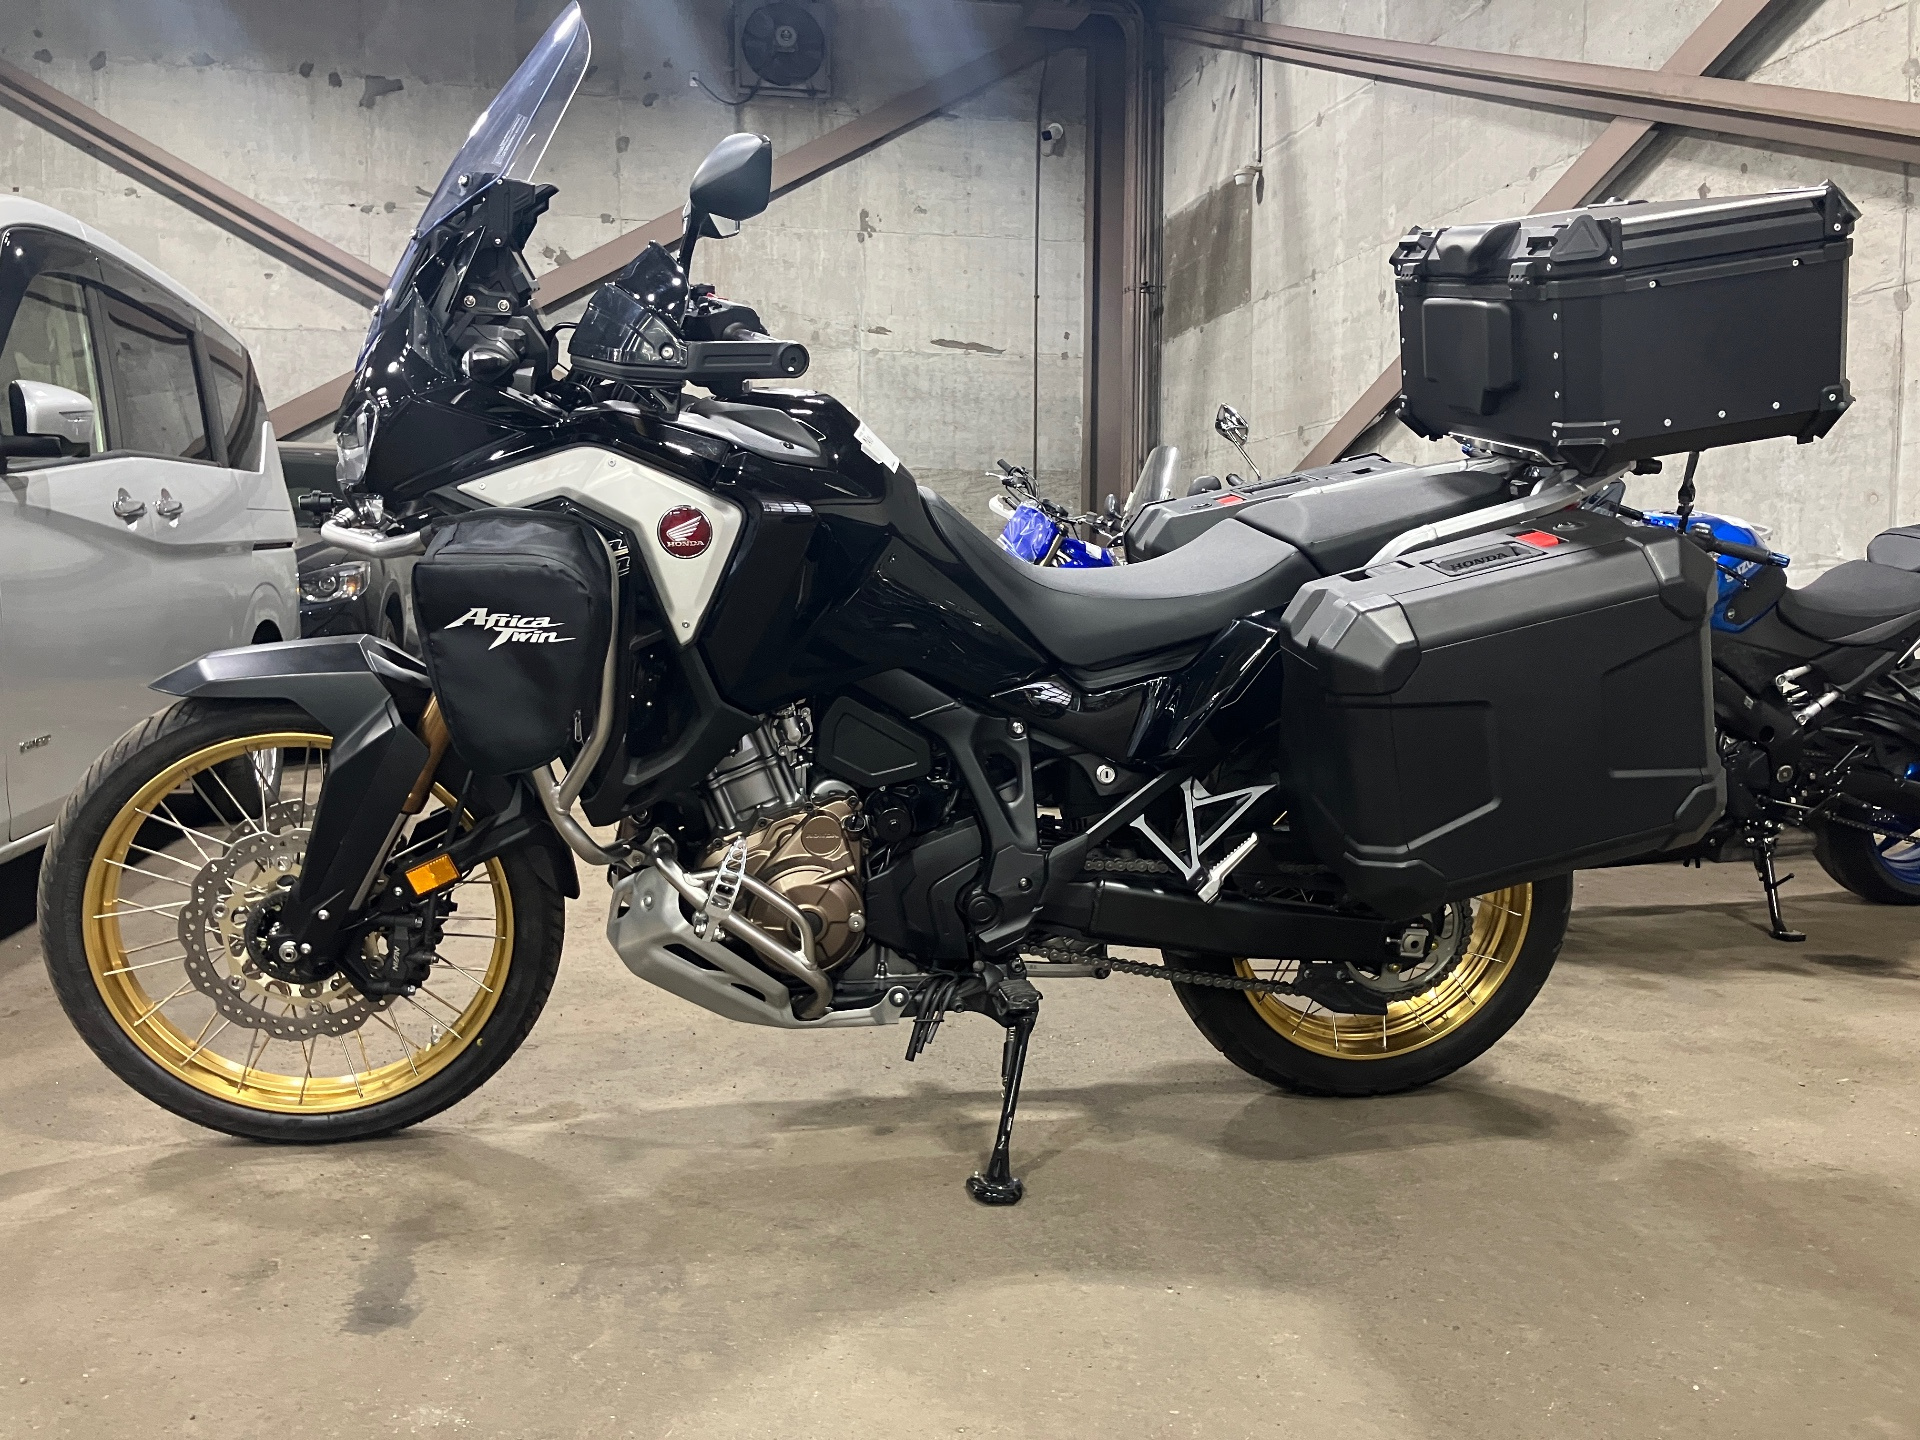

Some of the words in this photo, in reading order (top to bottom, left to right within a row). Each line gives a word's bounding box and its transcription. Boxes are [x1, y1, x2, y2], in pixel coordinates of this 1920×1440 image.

[1450, 551, 1509, 571] HONDA
[1724, 561, 1758, 582] SUZU
[443, 607, 565, 631] Africa
[488, 627, 577, 651] Twin
